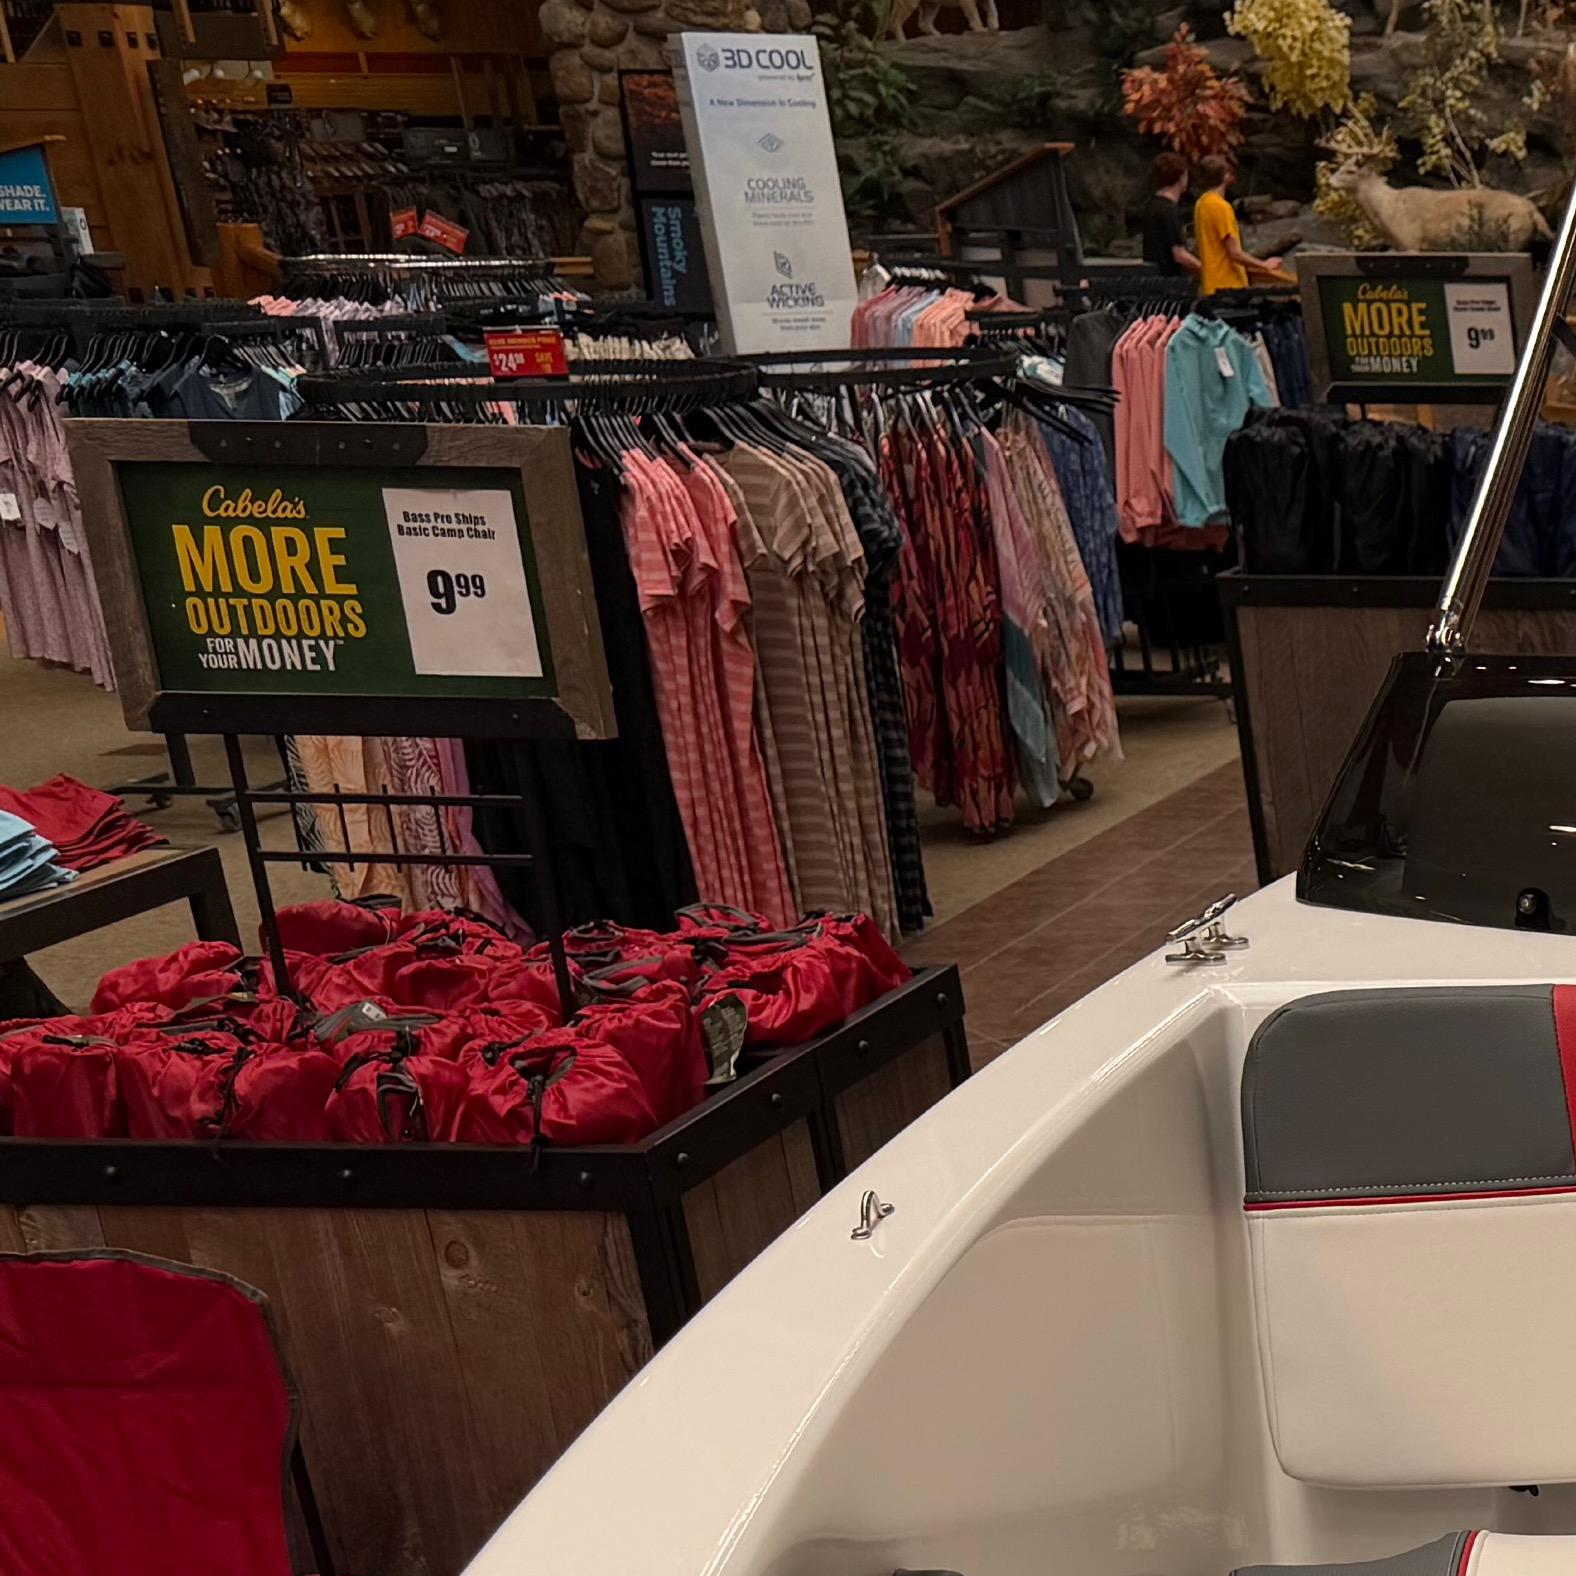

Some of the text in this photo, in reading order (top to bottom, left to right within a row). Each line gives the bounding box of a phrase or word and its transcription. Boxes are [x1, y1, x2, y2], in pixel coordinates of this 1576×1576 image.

[722, 48, 814, 70] 3D COOL
[747, 178, 807, 191] COOLING
[744, 191, 814, 203] MINERALS
[668, 207, 688, 274] Smoky
[652, 207, 677, 307] Mountains
[771, 283, 816, 296] ACTIVE
[1357, 283, 1409, 300] Cabela's
[767, 295, 825, 308] WICKING
[1343, 302, 1431, 336] MORE
[1346, 336, 1434, 357] OUTDOORS
[1369, 356, 1420, 374] MONEY
[202, 484, 307, 520] Cabela's
[403, 510, 432, 524] Bass
[433, 512, 453, 525] Pro
[397, 524, 496, 541] Basic Camp Chair
[171, 524, 359, 596] MORE
[185, 596, 368, 639] OUTDOORS
[206, 637, 236, 654] FOR
[199, 652, 239, 670] YOUR
